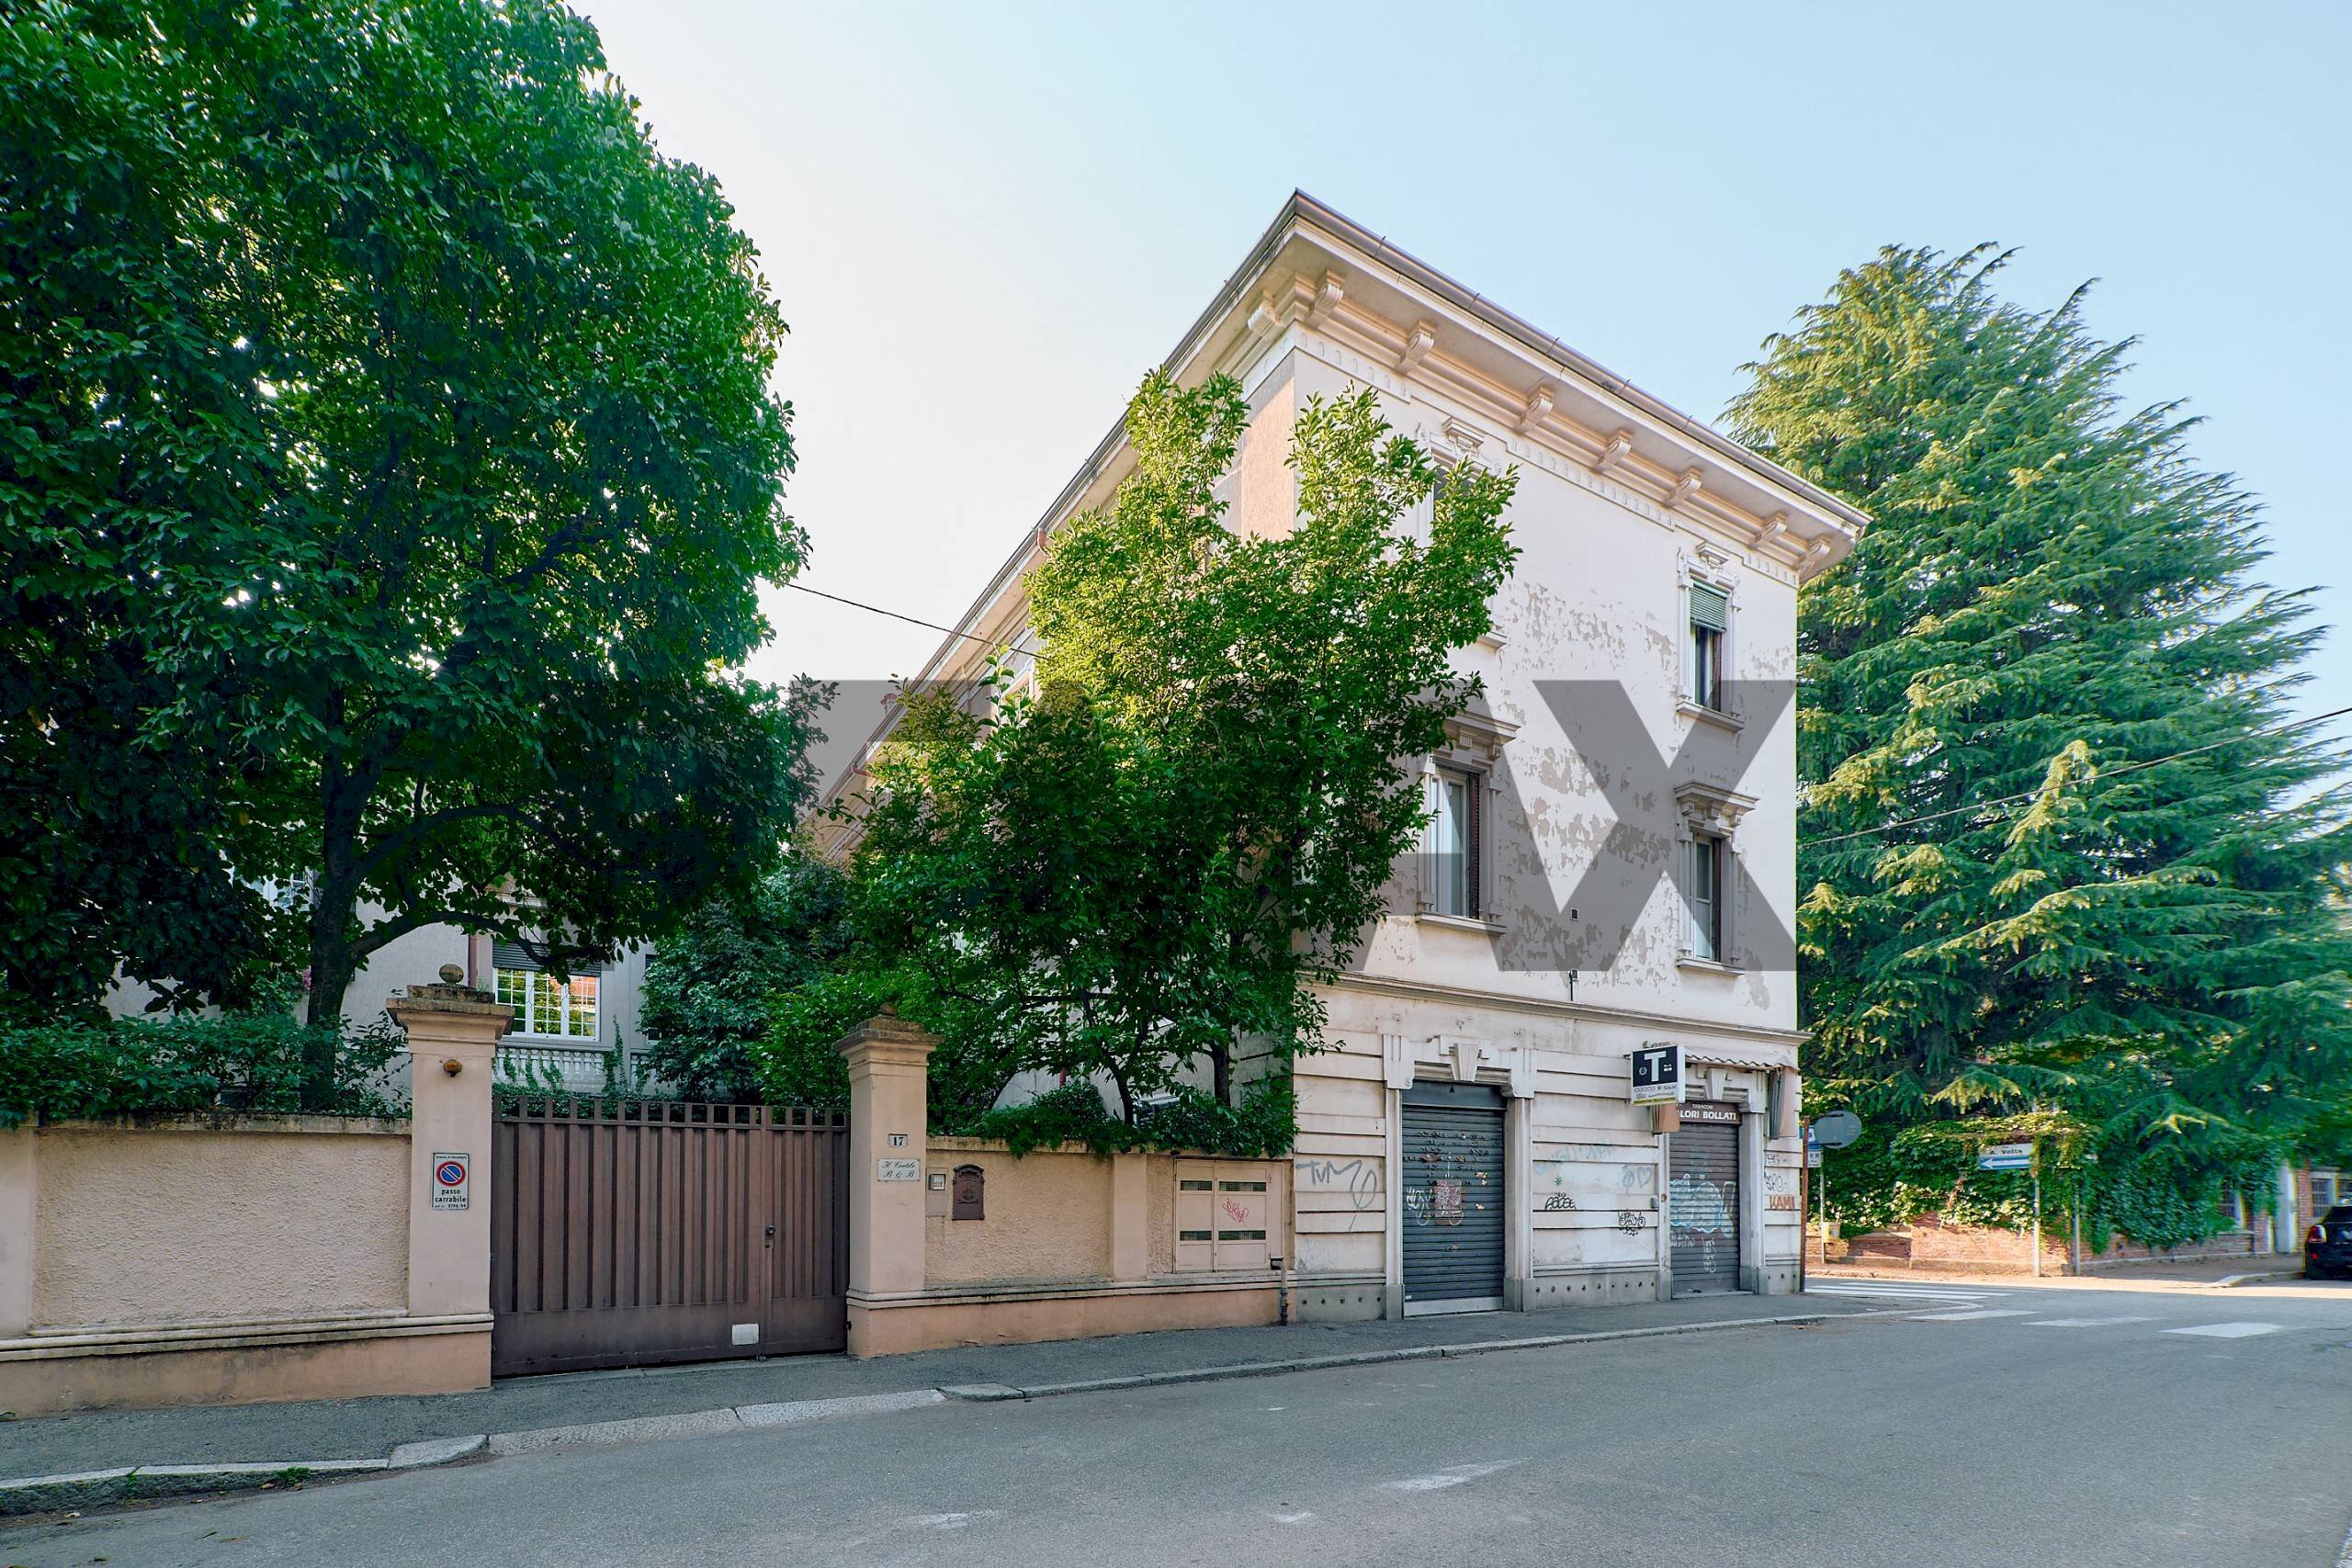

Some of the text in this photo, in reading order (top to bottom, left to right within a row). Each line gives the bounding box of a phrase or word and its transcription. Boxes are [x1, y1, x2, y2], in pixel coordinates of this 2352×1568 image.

[1644, 1051, 1667, 1082] T
[1677, 1110, 1736, 1121] LORI BOLLATI
[893, 1136, 904, 1146] 17
